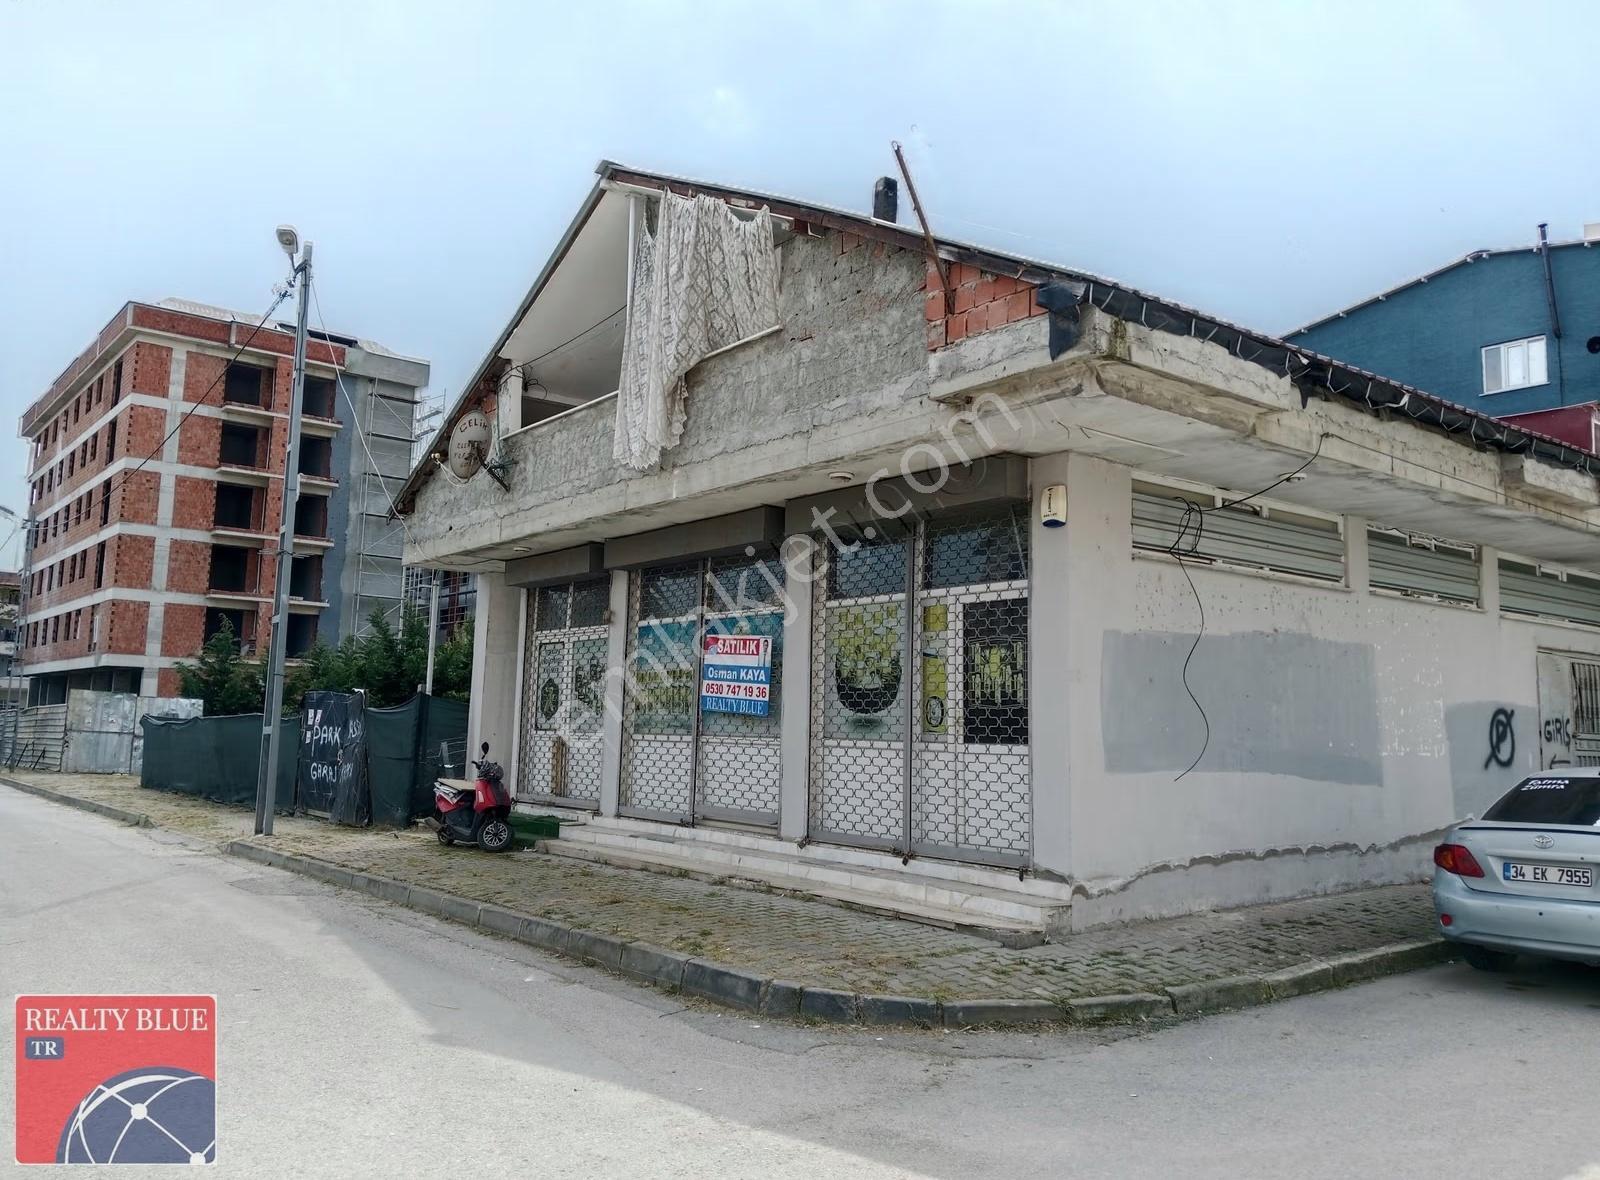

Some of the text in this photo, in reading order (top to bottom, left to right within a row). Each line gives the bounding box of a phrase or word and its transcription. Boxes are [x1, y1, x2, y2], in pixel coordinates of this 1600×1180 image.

[717, 639, 757, 655] SATILIK
[708, 667, 766, 681] Osman KAYA
[705, 683, 767, 698] 0530 747 19 36
[706, 697, 740, 712] REALTY
[740, 700, 764, 715] BLUE
[311, 725, 341, 755] PARK
[310, 762, 337, 783] GARAJ
[1511, 865, 1525, 879] 34
[1533, 867, 1548, 881] EK
[1557, 868, 1590, 885] 7955
